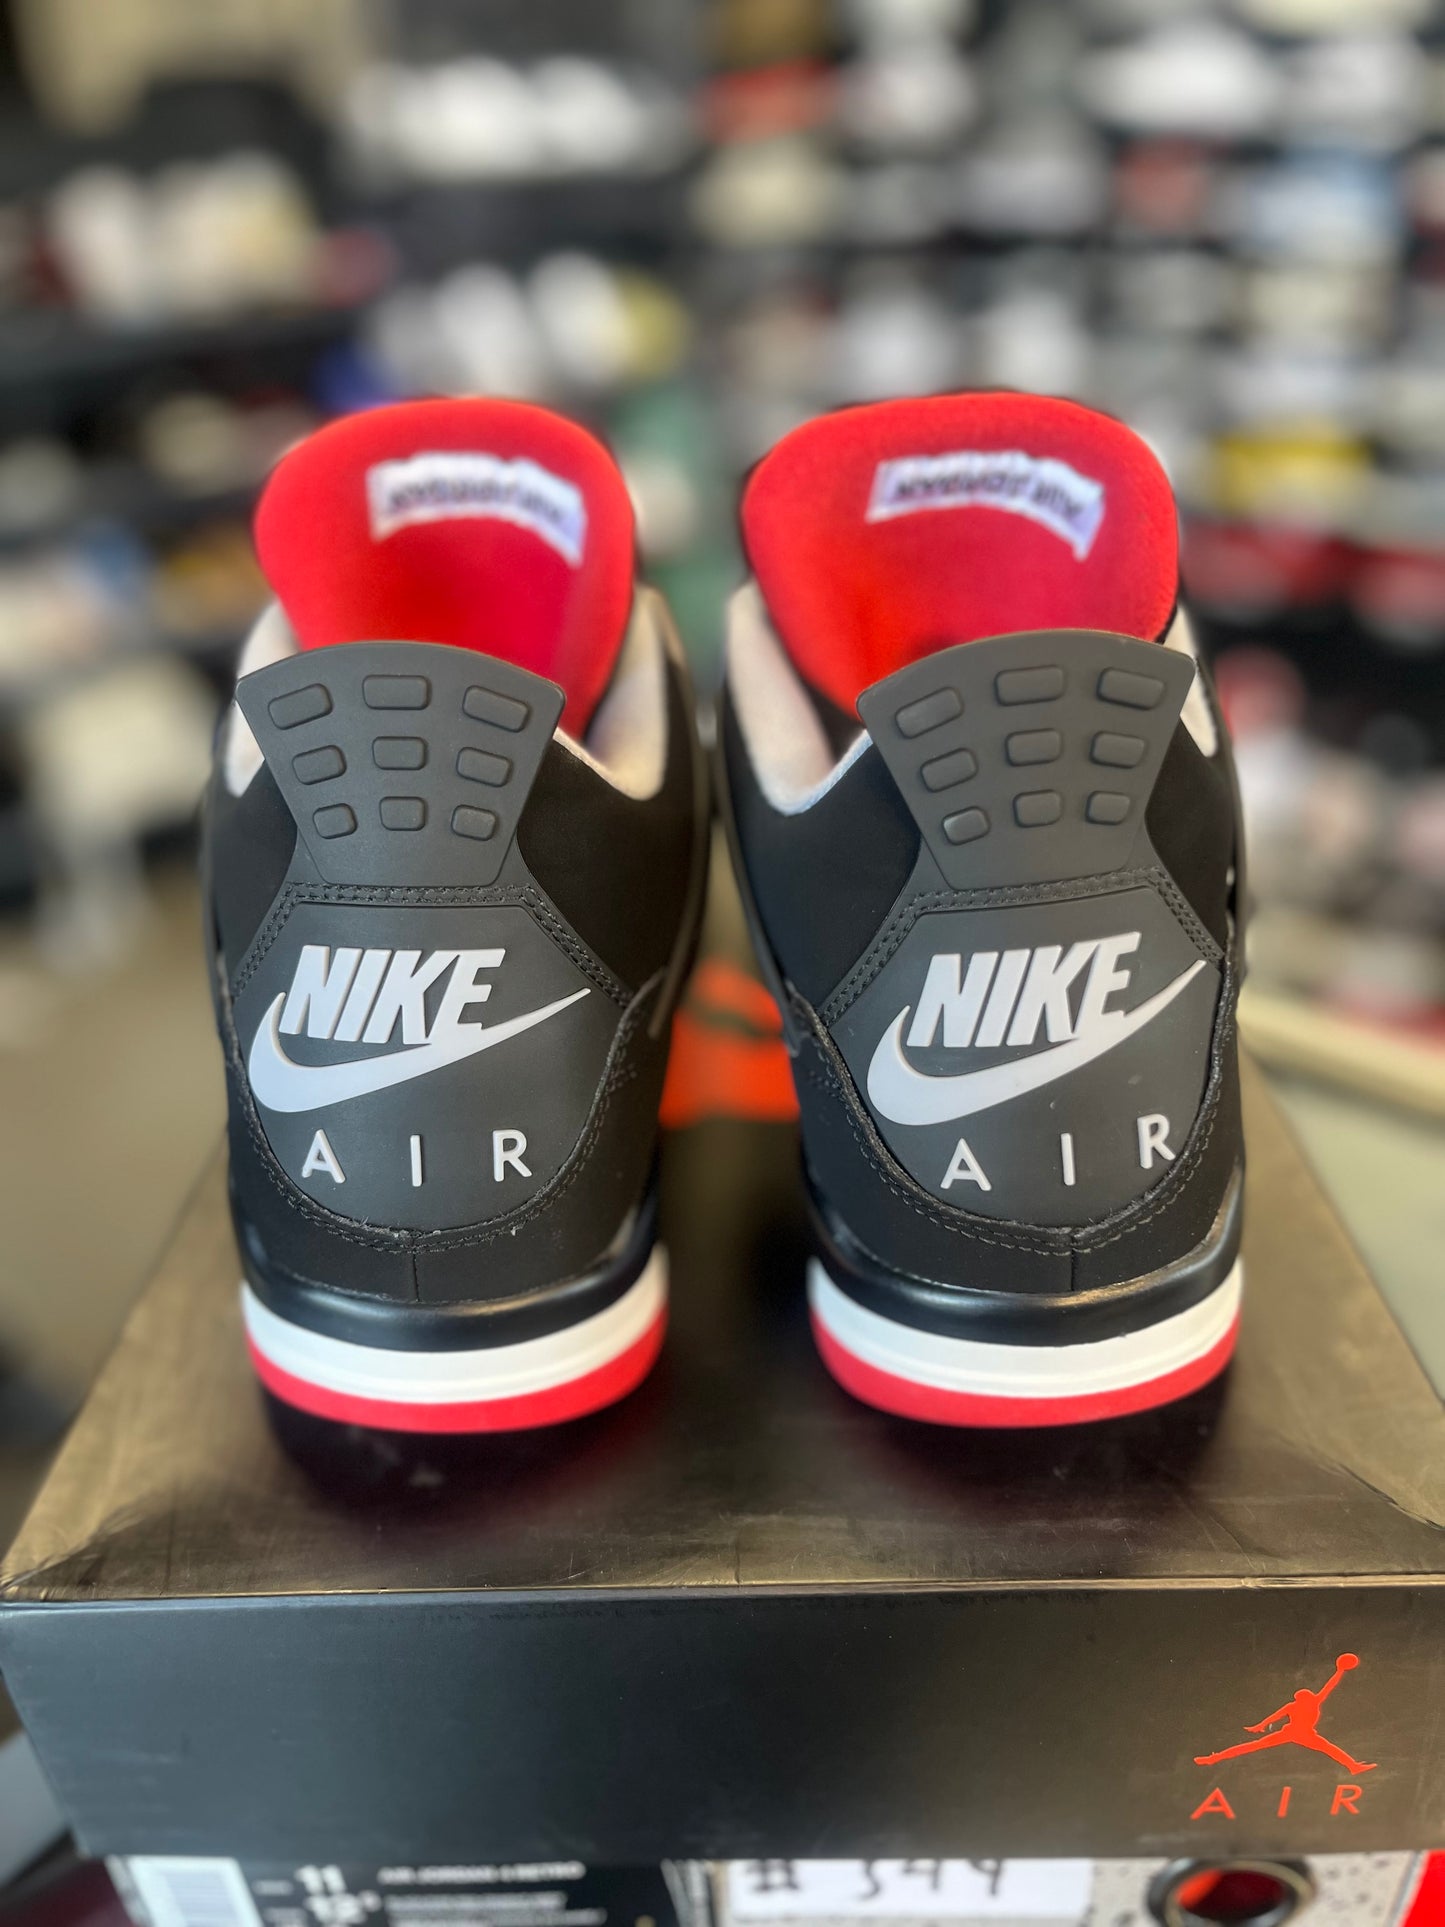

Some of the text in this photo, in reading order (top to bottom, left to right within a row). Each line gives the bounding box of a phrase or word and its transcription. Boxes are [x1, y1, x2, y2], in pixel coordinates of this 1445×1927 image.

[278, 945, 506, 1045] NIKE
[906, 931, 1141, 1048] NIKE
[302, 1129, 532, 1187] AIR
[940, 1113, 1176, 1191] AIR
[1190, 1784, 1363, 1819] AIR
